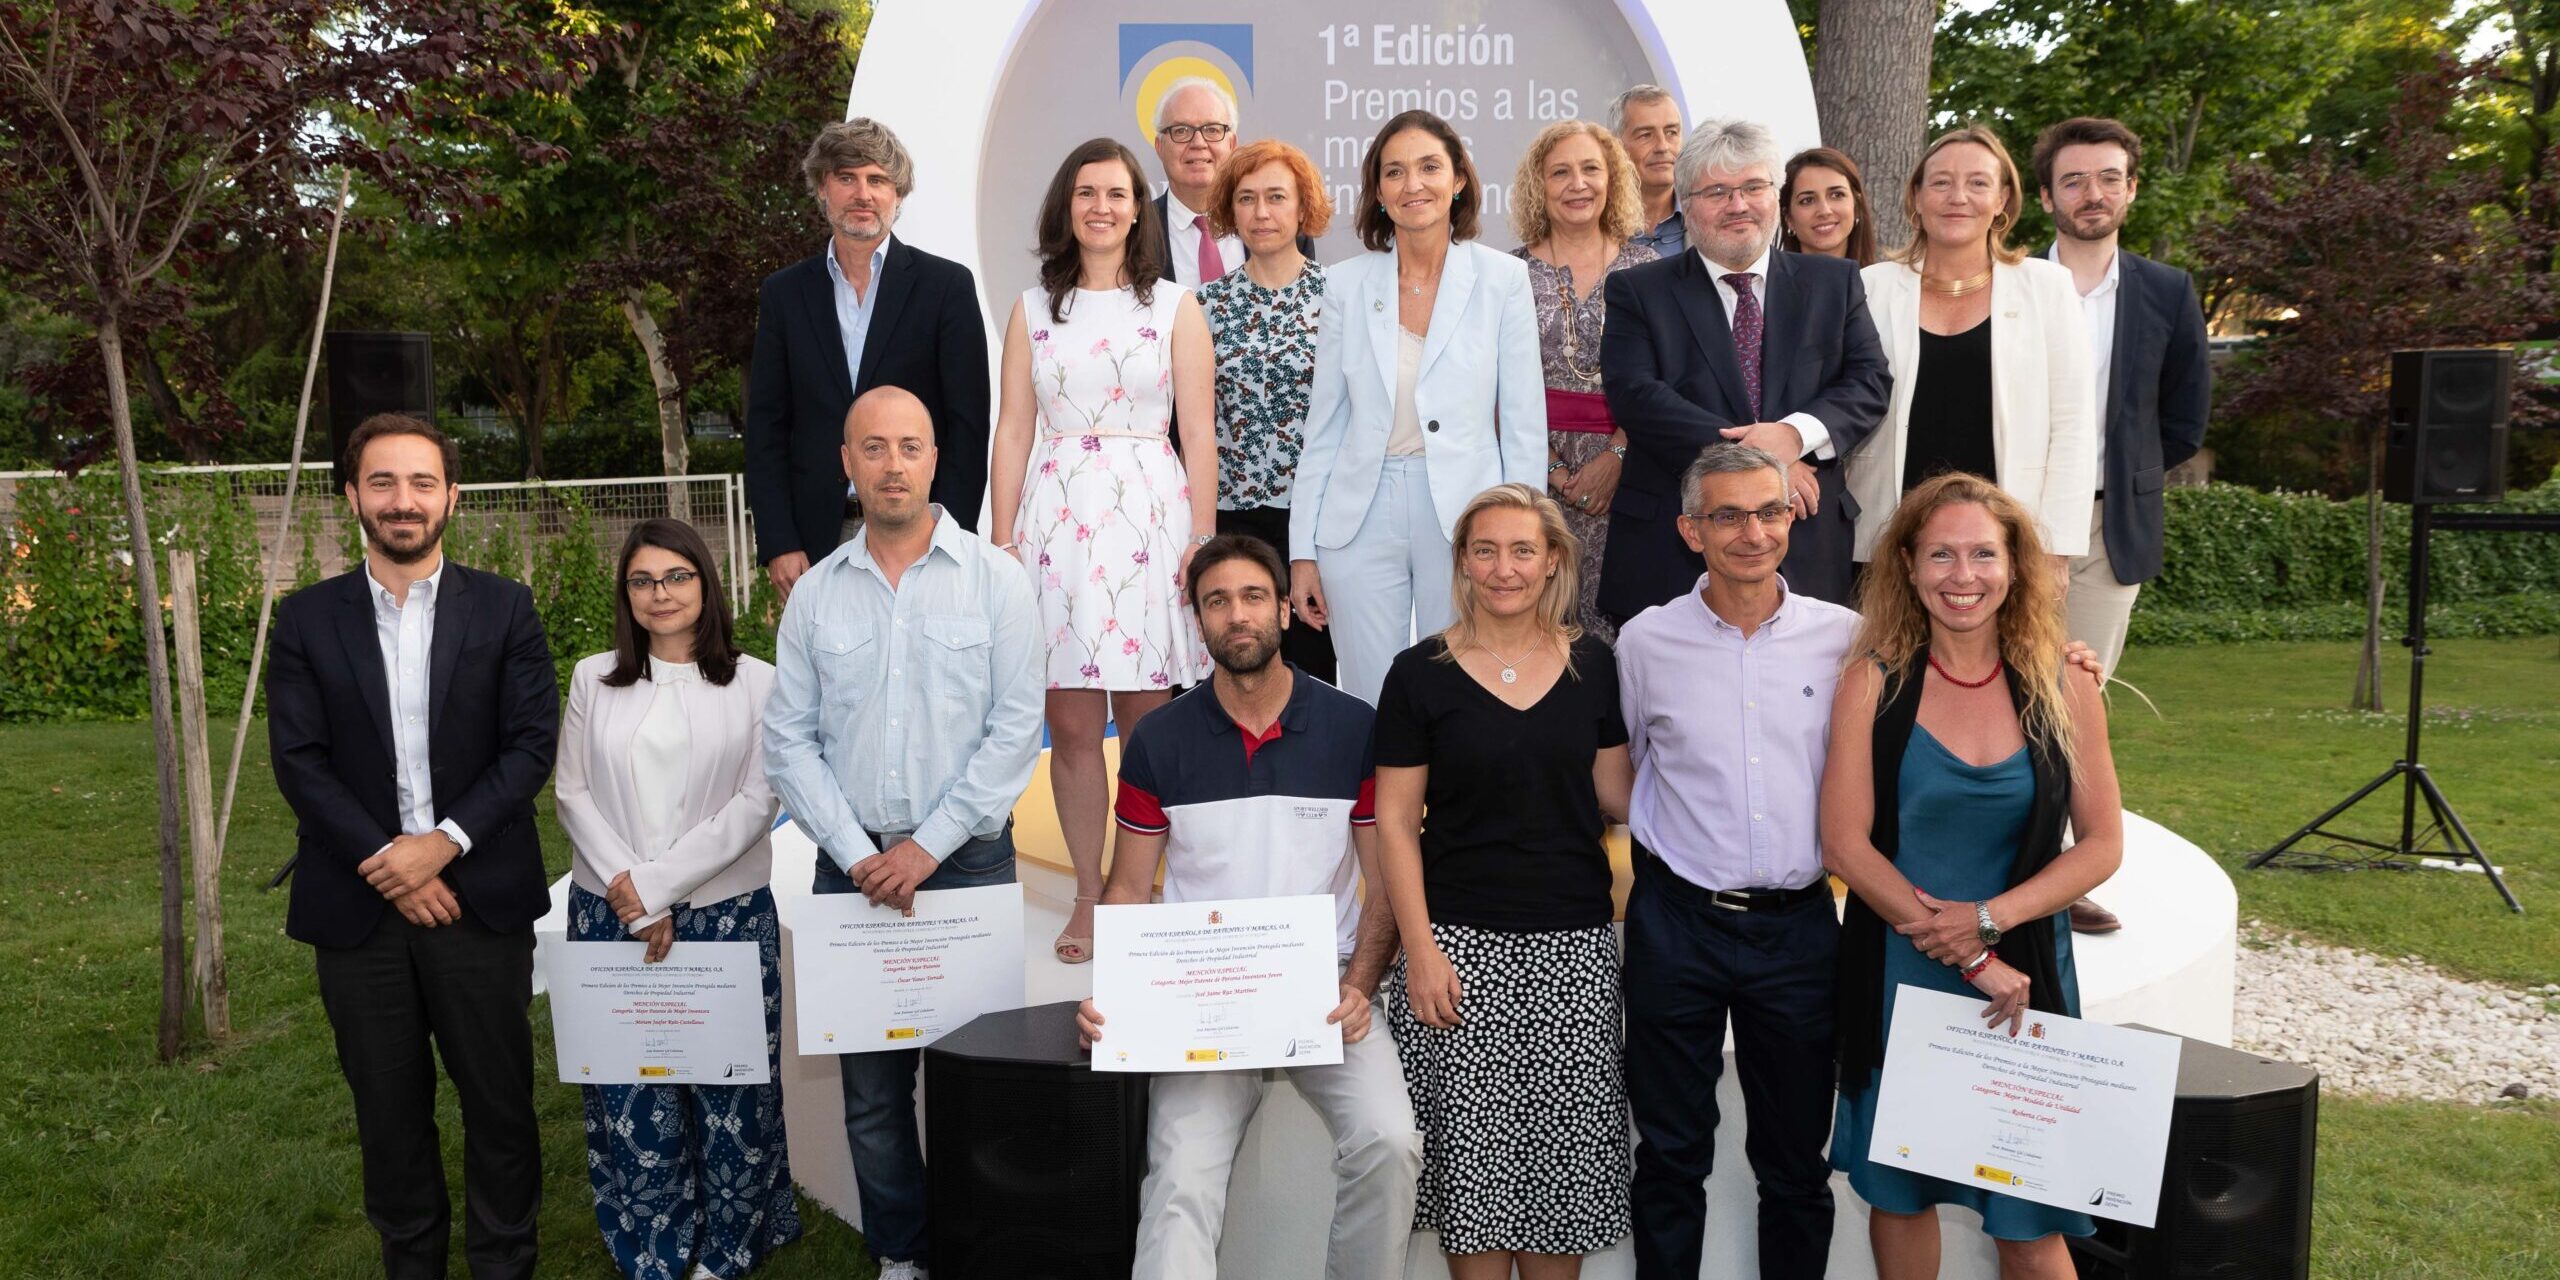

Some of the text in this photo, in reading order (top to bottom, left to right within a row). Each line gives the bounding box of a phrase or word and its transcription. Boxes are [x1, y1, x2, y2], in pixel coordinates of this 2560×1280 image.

[1318, 24, 1514, 66] 1ª Edición
[1324, 80, 1580, 121] Premios a las
